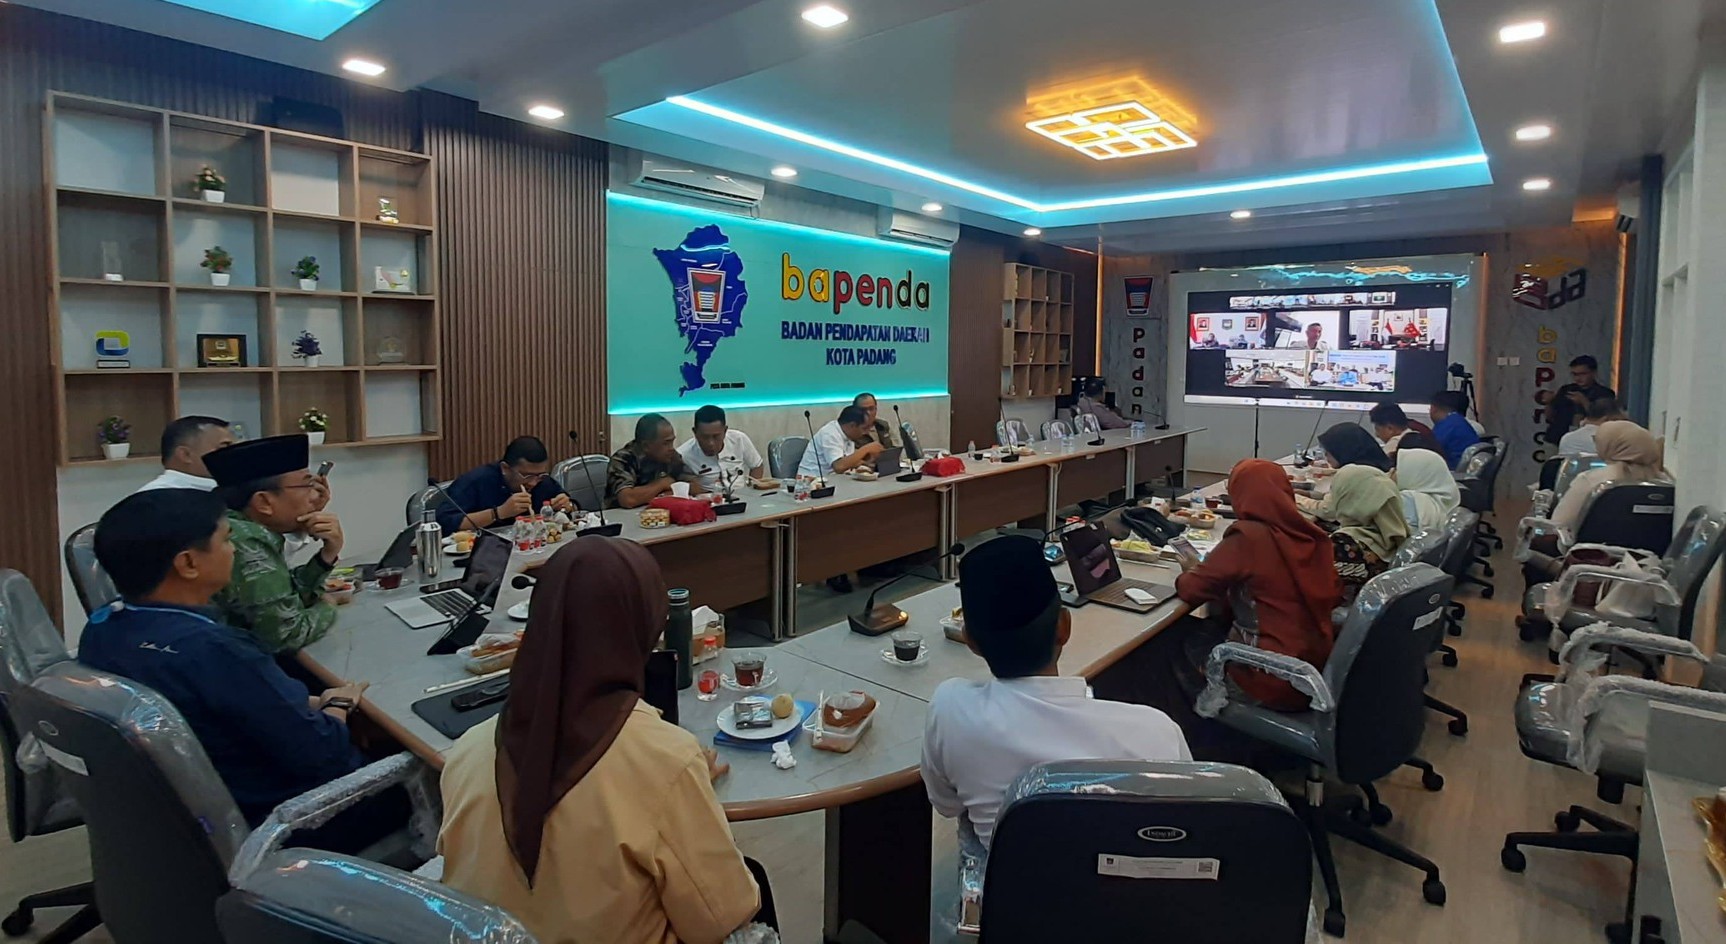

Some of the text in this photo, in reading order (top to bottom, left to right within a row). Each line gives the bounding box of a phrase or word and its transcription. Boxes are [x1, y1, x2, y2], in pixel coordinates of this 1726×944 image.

[781, 252, 931, 315] bapenda
[781, 320, 823, 341] BADAN
[824, 323, 892, 343] PENDAPATAN
[825, 347, 897, 366] KOTA PADANG
